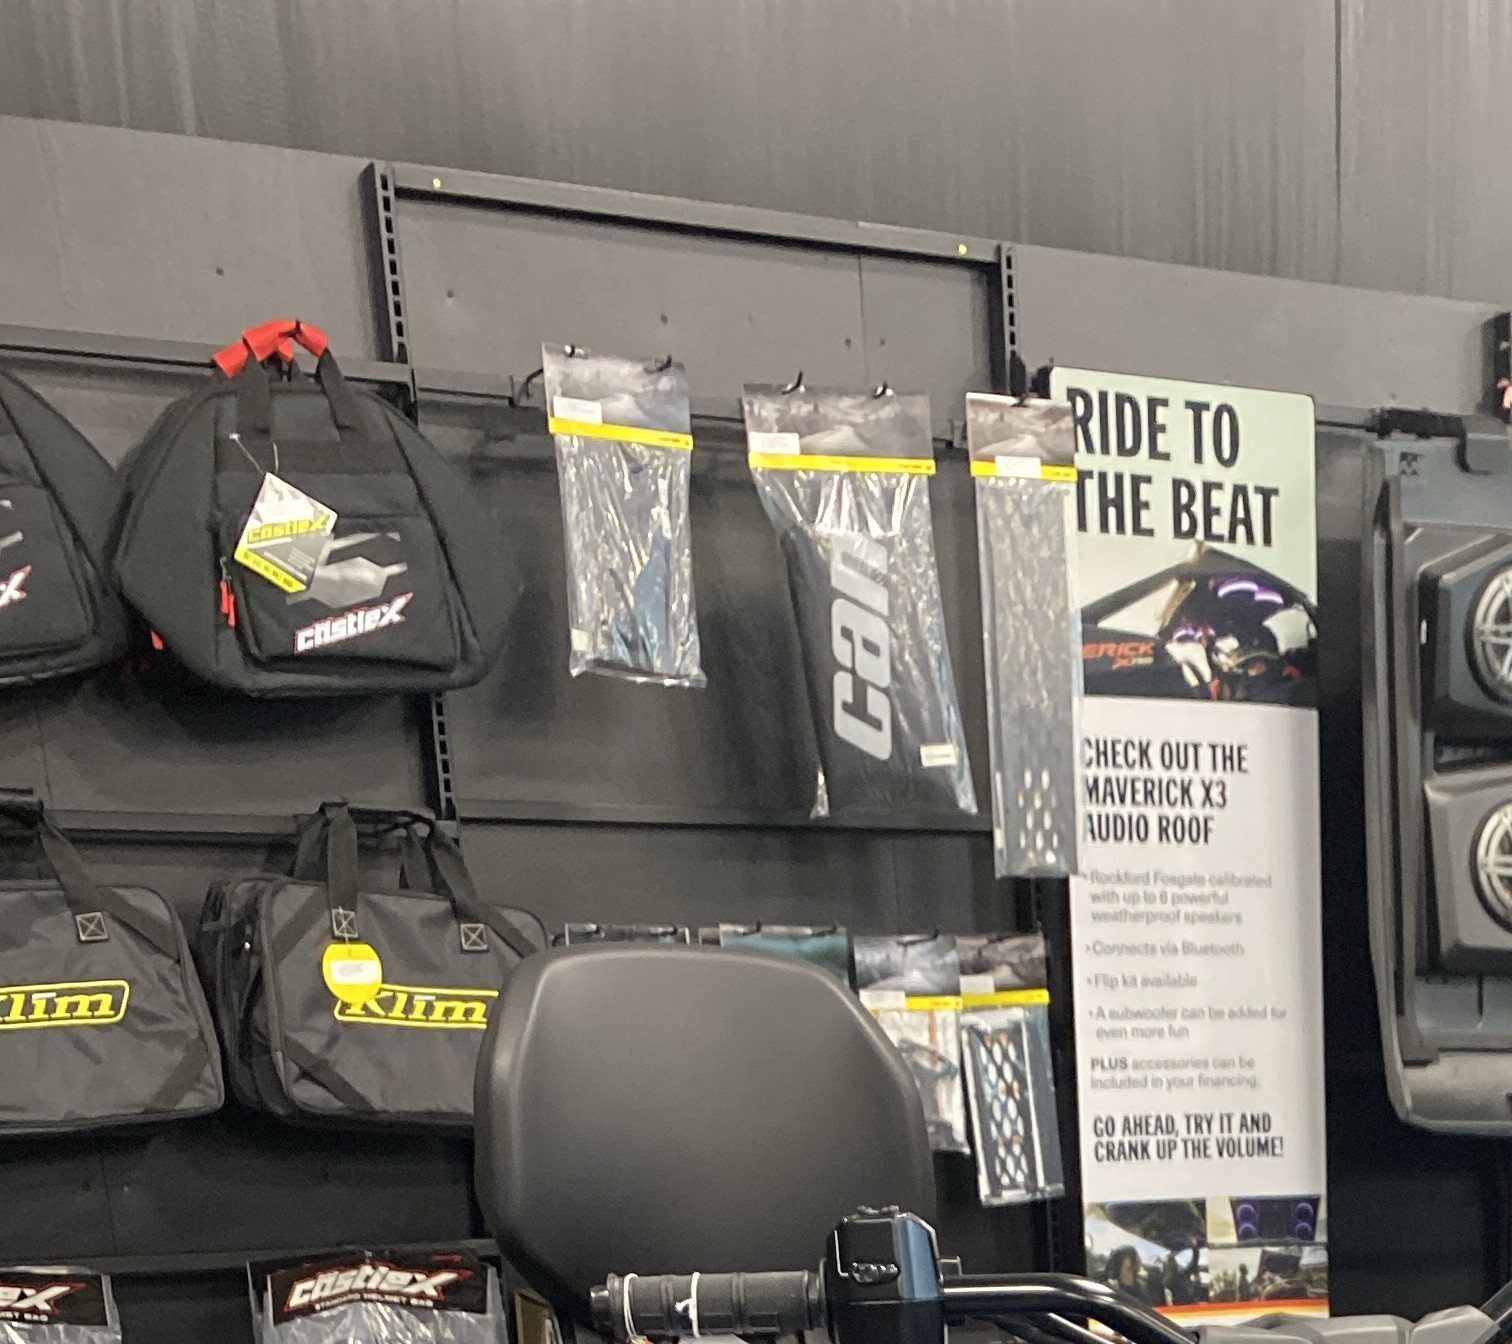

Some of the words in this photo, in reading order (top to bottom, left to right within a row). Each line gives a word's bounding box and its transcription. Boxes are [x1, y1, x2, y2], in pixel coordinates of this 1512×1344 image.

[1067, 387, 1171, 461] RIDE
[1184, 400, 1240, 468] TO
[1076, 469, 1155, 537] THE
[1172, 476, 1279, 547] BEAT
[1083, 642, 1154, 659] ERICK
[1081, 737, 1152, 770] CHECK
[1160, 741, 1203, 772] OUT
[1209, 742, 1249, 774] THE
[1083, 775, 1193, 807] MAVERICK
[1202, 778, 1227, 809] X3
[1158, 814, 1214, 844] ROOF
[1090, 1056, 1128, 1071] PLUS
[1212, 1056, 1236, 1069] can
[1238, 1056, 1256, 1069] be
[1151, 1075, 1164, 1088] in
[1093, 1114, 1116, 1137] GO
[1122, 1113, 1179, 1138] AHEAD,
[1184, 1113, 1214, 1135] TRY
[1220, 1112, 1235, 1134] IT
[1239, 1112, 1272, 1134] AND
[1094, 1137, 1152, 1162] CRANK
[1156, 1138, 1177, 1160] UP
[1182, 1138, 1210, 1160] THE
[1215, 1136, 1284, 1159] VOLUME!
